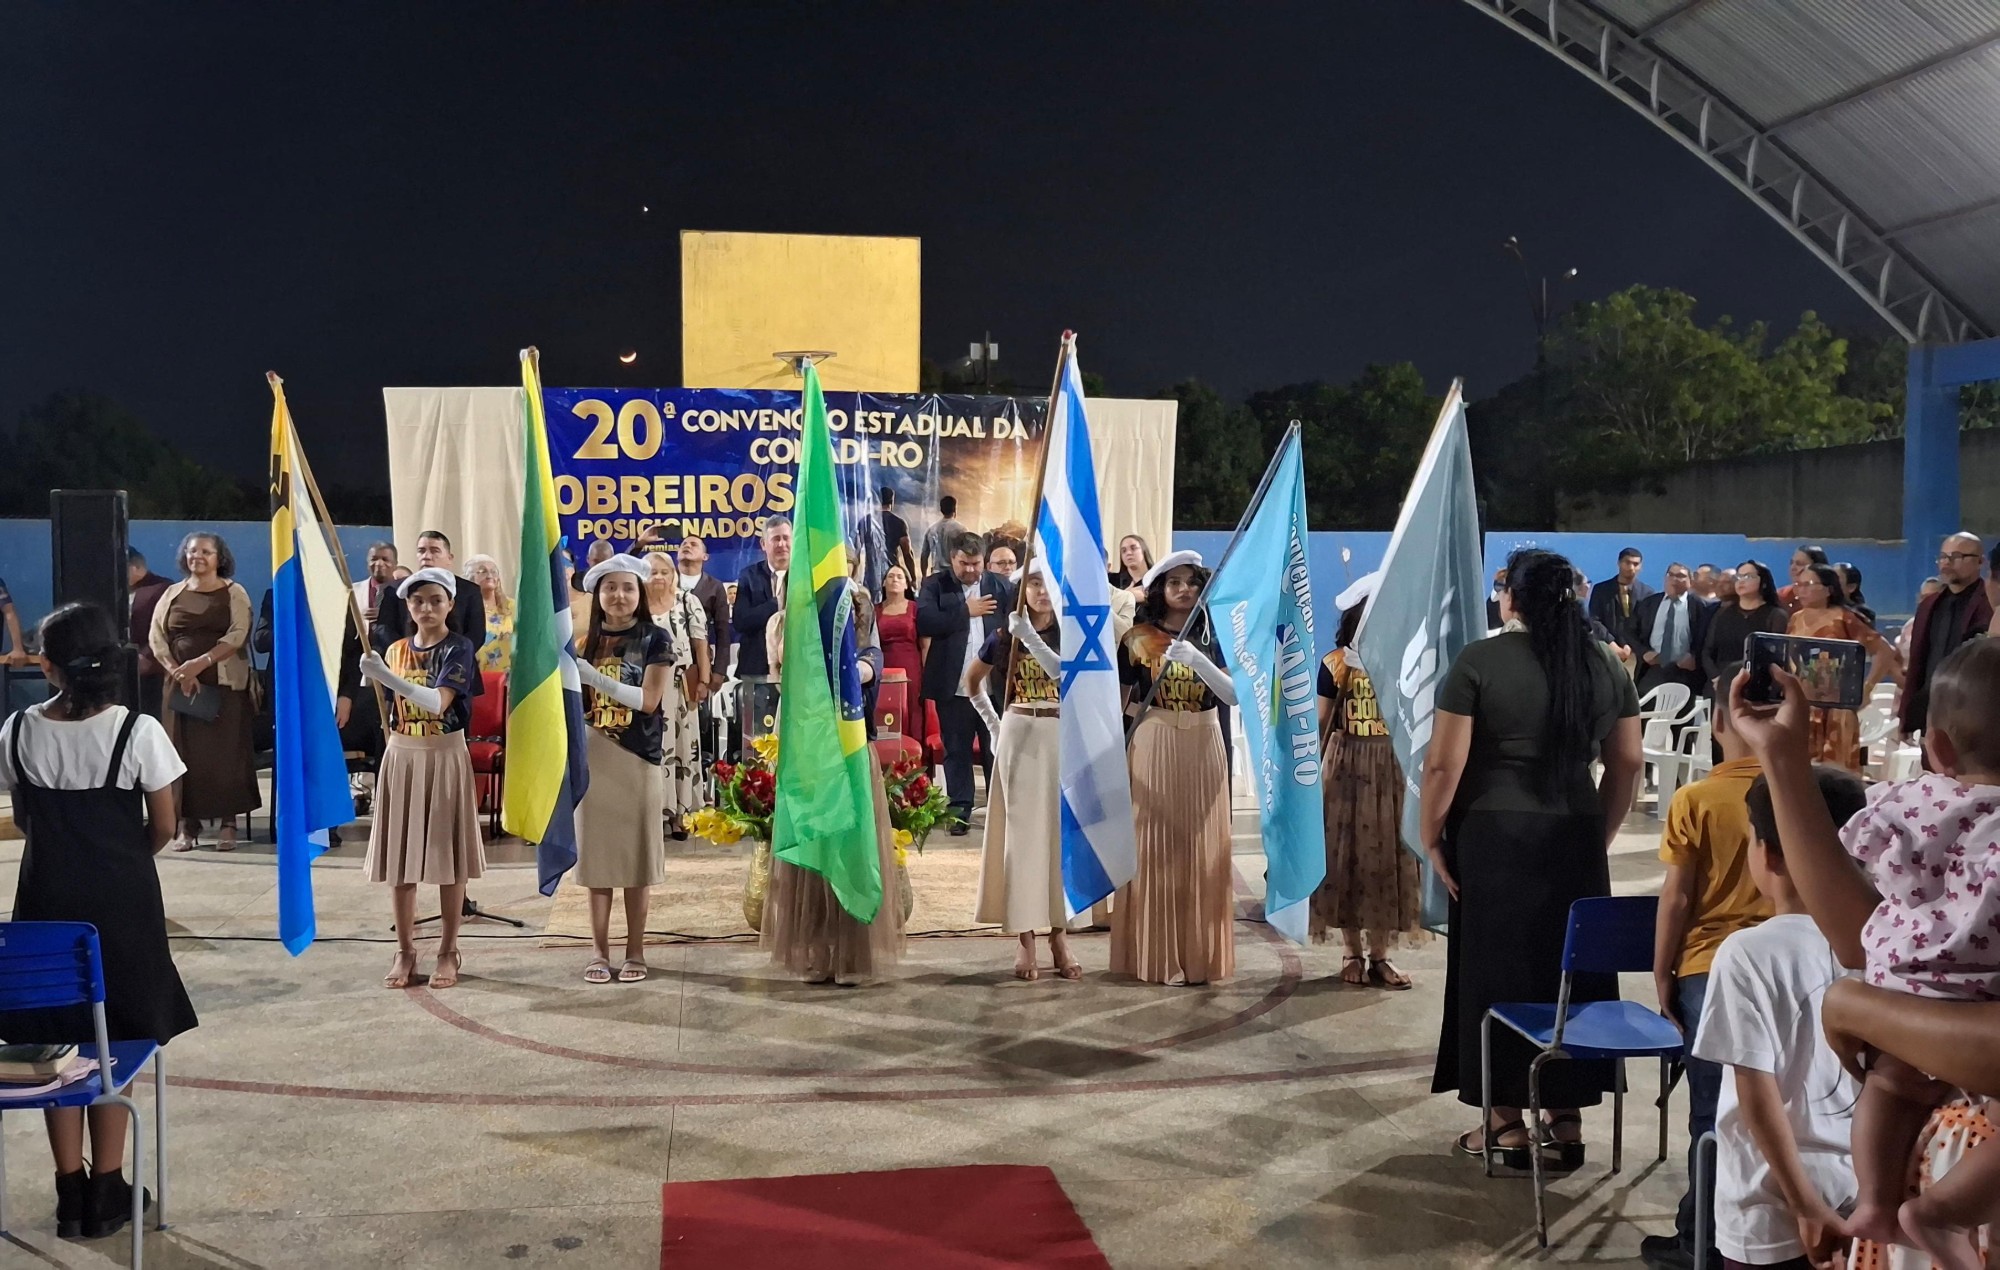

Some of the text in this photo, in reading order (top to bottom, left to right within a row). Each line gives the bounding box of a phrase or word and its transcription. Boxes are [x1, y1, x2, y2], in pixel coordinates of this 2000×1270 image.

[681, 408, 849, 433] CONVENO
[854, 410, 986, 439] ESTADUAL
[993, 417, 1029, 441] DA
[552, 473, 795, 515] OBREIROS
[577, 516, 768, 541] POSICNADOS
